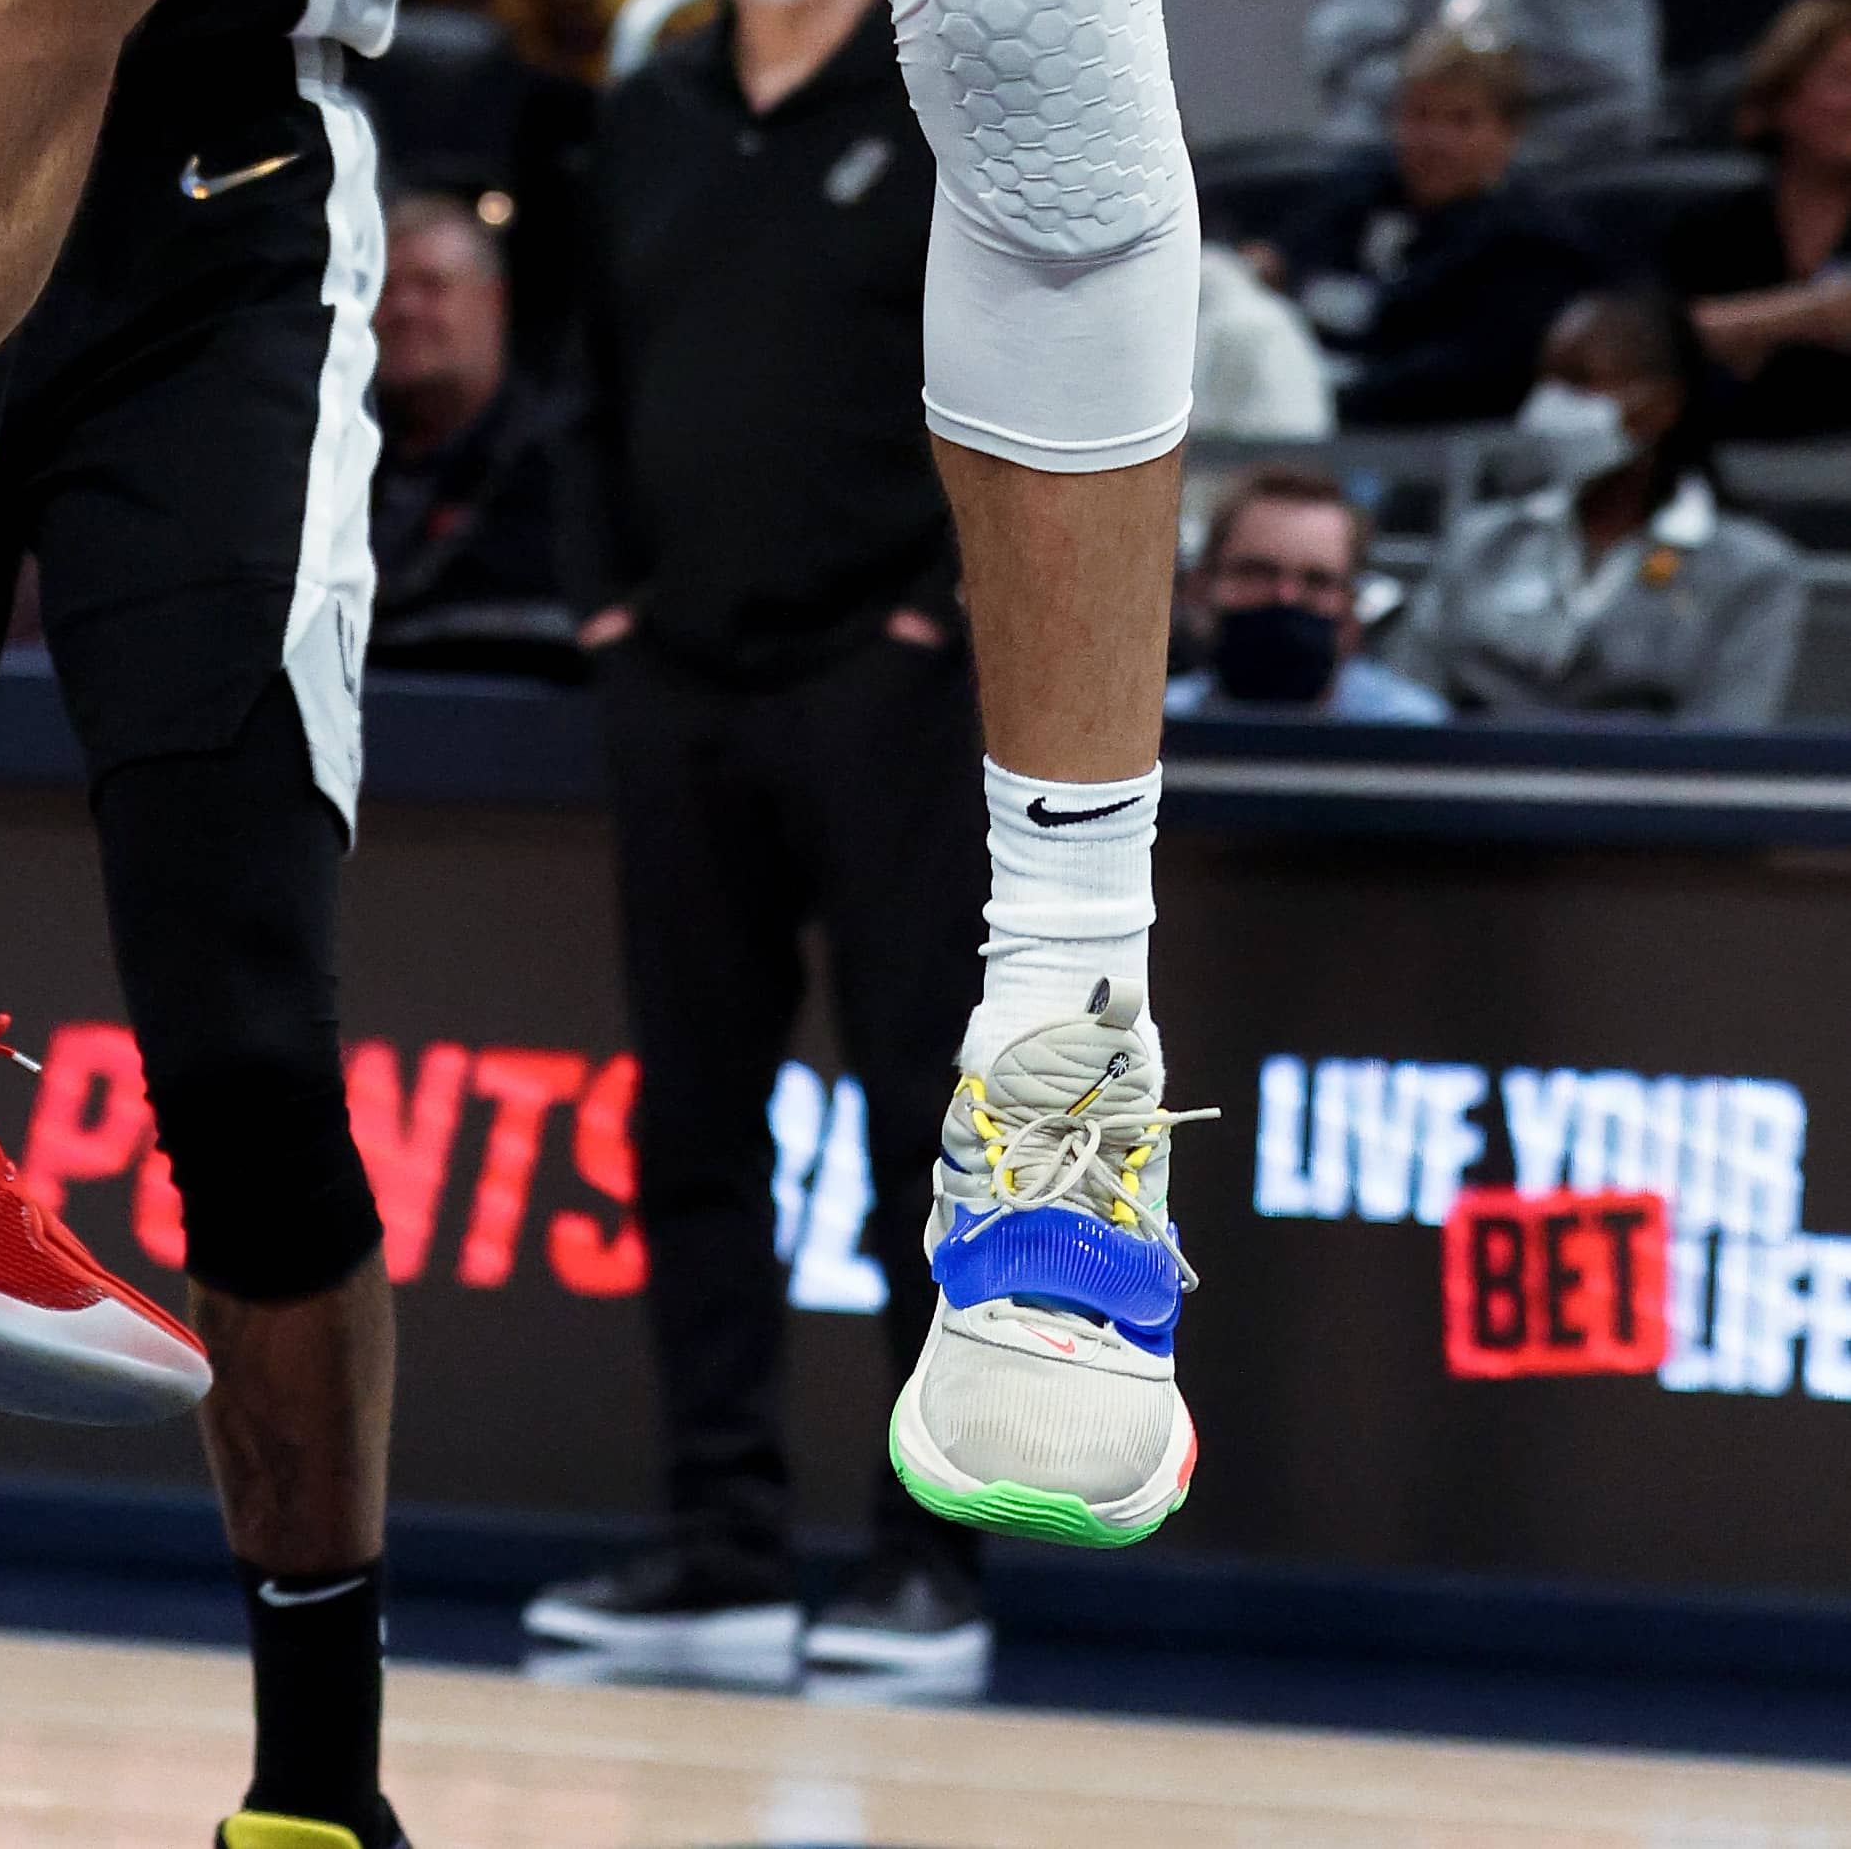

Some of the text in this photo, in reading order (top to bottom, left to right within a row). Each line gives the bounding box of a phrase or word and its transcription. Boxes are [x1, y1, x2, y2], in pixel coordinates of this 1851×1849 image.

[22, 1019, 648, 1297] PNTS
[1252, 1051, 1808, 1243] LIVE YOUR
[1470, 1207, 1648, 1353] BET
